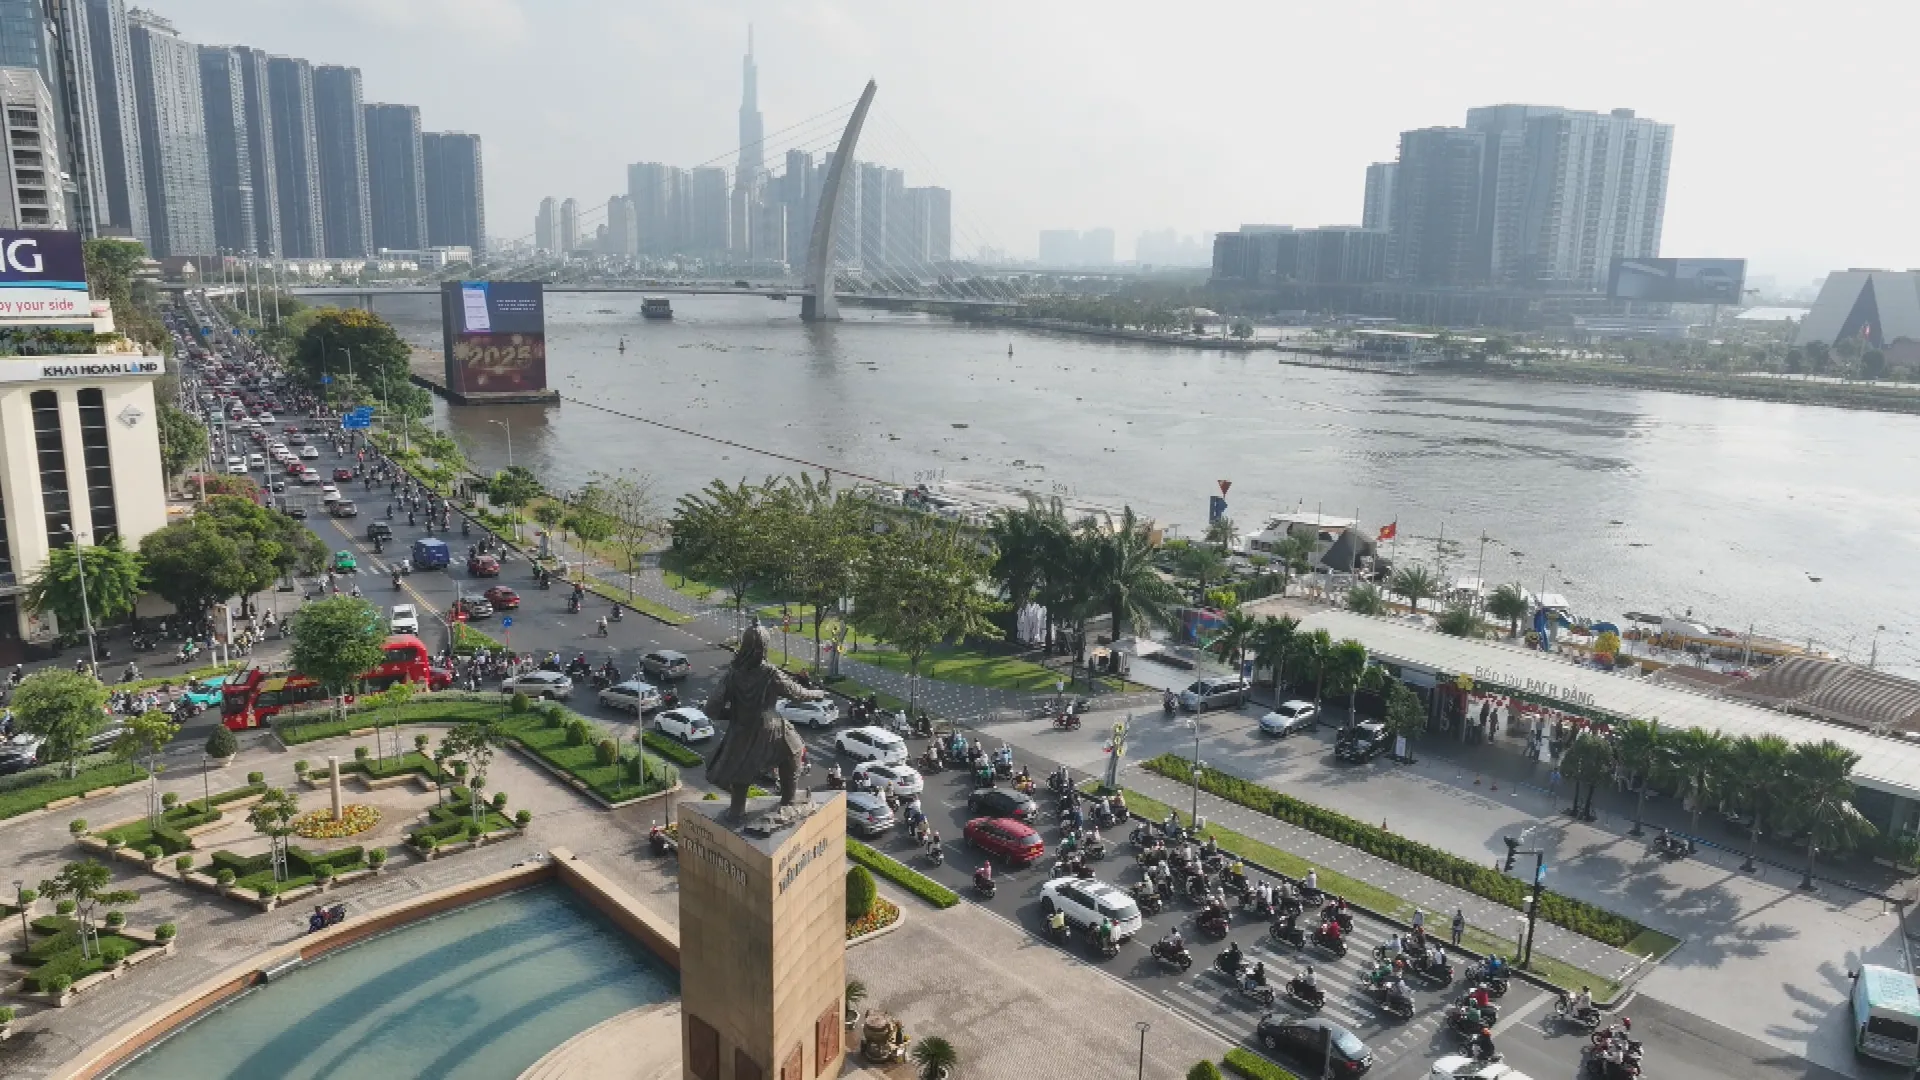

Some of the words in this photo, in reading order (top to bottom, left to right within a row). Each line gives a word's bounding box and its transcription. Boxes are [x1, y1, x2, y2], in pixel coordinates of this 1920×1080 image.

[16, 301, 44, 312] your
[49, 298, 74, 311] side
[468, 345, 531, 369] 2025
[43, 366, 78, 377] KHAI
